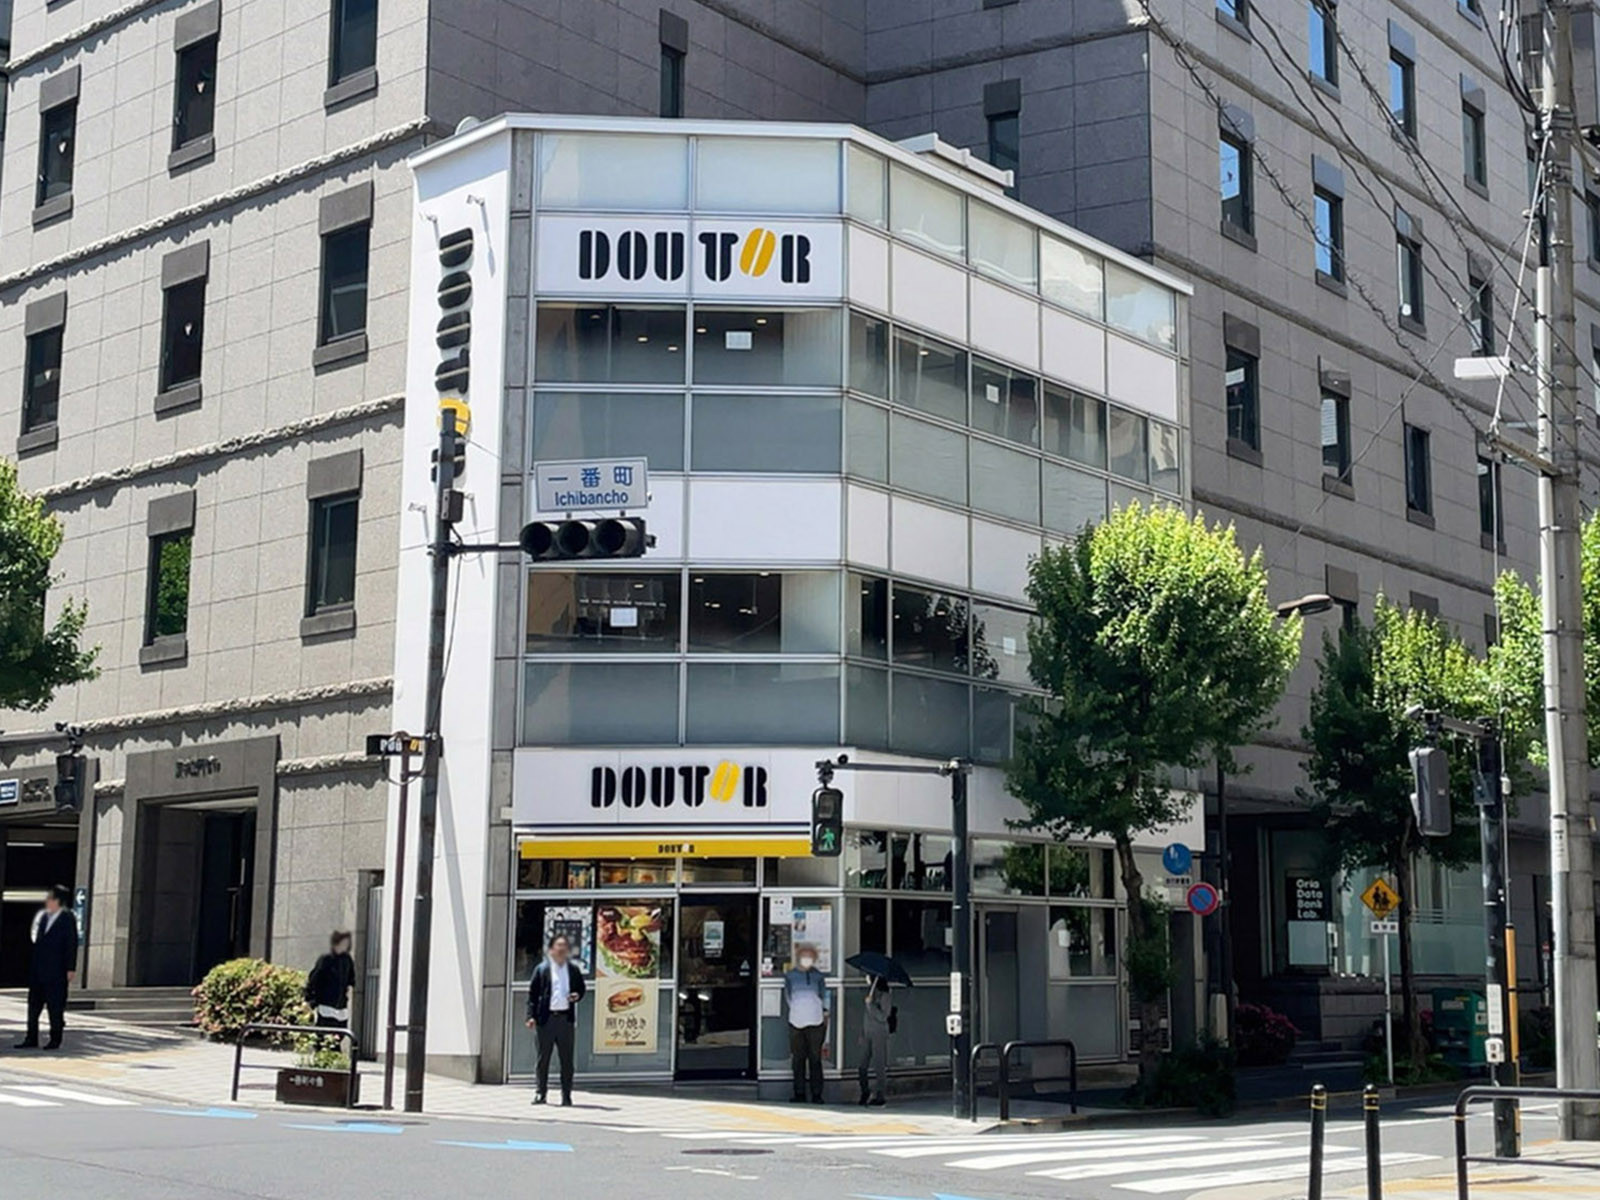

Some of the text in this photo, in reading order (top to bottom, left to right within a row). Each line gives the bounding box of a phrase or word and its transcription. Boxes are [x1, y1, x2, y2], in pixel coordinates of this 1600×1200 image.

[579, 228, 811, 283] DOUTOR
[548, 466, 633, 488] 一番町
[555, 490, 629, 506] Ichibancho
[591, 760, 767, 808] DOUTOR
[1296, 889, 1323, 899] Data
[1297, 899, 1323, 909] Bank
